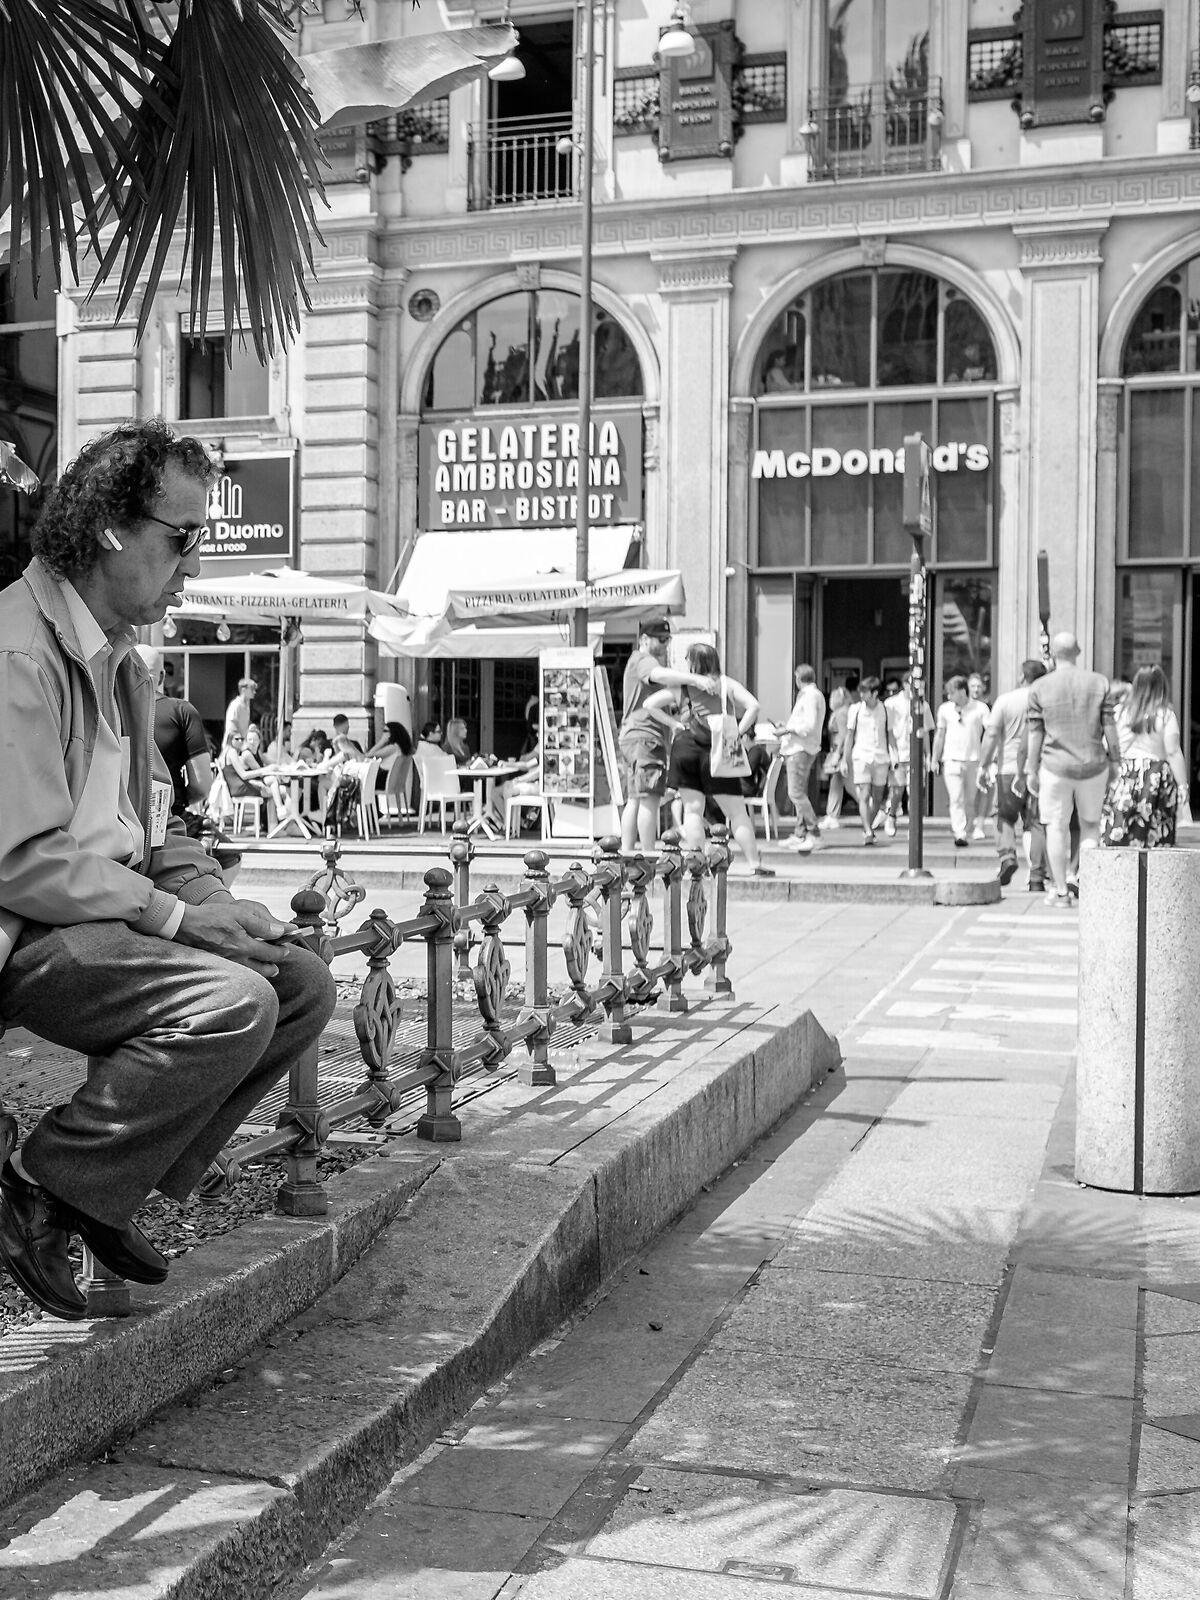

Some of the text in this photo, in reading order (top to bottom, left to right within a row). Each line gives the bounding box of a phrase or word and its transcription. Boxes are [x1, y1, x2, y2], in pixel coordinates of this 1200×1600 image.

[437, 420, 619, 463] GELATERIA
[434, 456, 621, 492] AMBROSIANA
[751, 441, 990, 478] McDond's
[441, 498, 486, 524] BAR
[215, 521, 284, 540] Duomo
[590, 583, 661, 598] RISTORANTE
